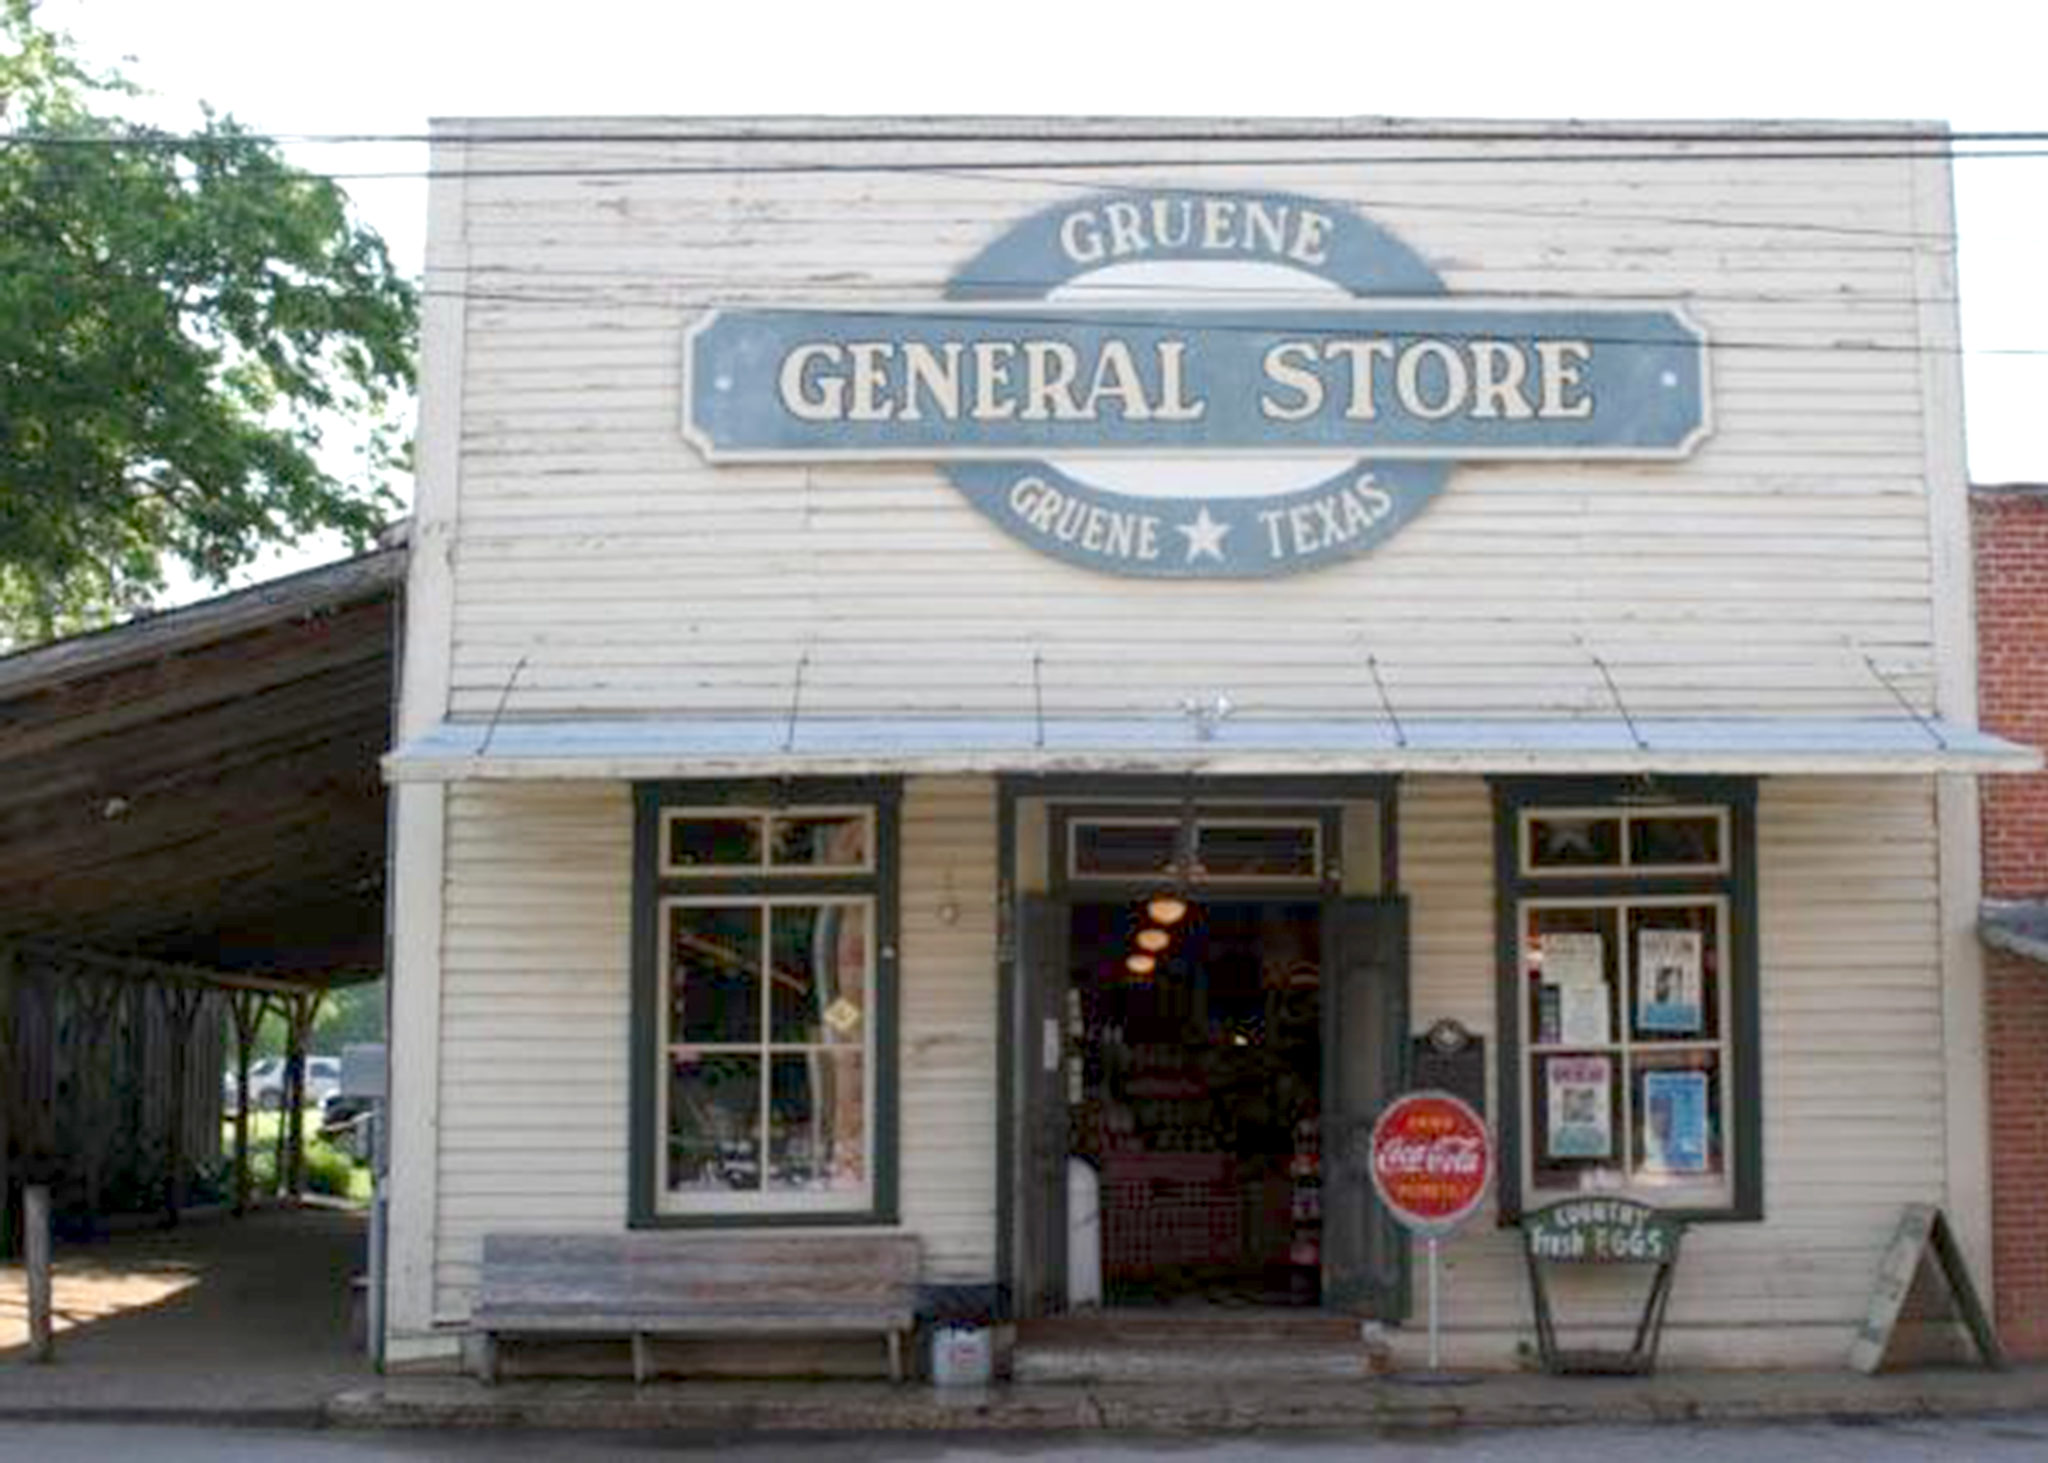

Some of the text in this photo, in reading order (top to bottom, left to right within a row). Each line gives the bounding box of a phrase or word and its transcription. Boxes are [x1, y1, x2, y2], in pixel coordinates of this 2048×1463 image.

[1060, 199, 1333, 264] GRUENE
[778, 340, 1594, 421] GENERAL STORE
[1009, 473, 1393, 560] GRUENE TEXAS
[1596, 1228, 1662, 1257] EGGS
